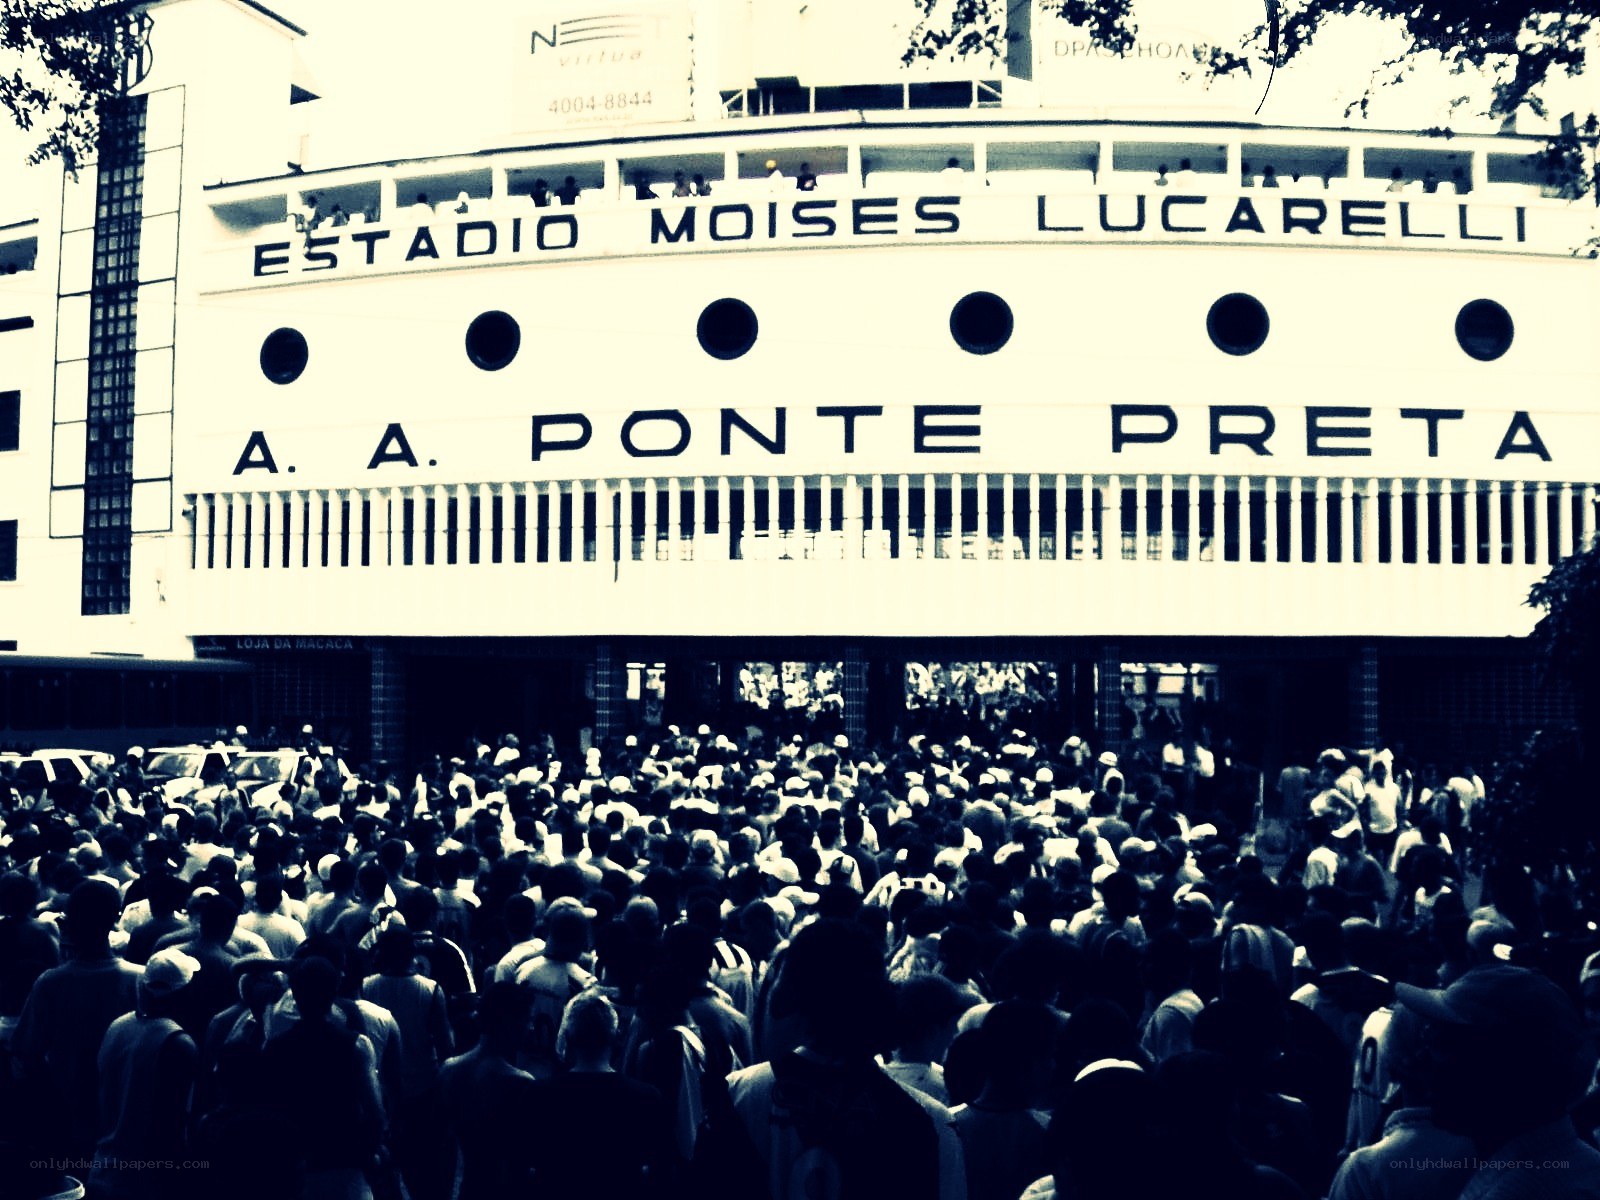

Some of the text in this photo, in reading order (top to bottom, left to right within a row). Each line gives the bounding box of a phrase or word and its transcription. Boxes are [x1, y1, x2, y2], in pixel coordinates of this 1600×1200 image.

[548, 91, 653, 114] 4004-8844
[253, 194, 1526, 277] ESTADIO MOISES LUCARELLI
[233, 404, 1552, 476] A. A. PONTE PRETA
[236, 638, 270, 650] LOJA
[273, 639, 292, 650] DA
[295, 638, 354, 650] MACACA
